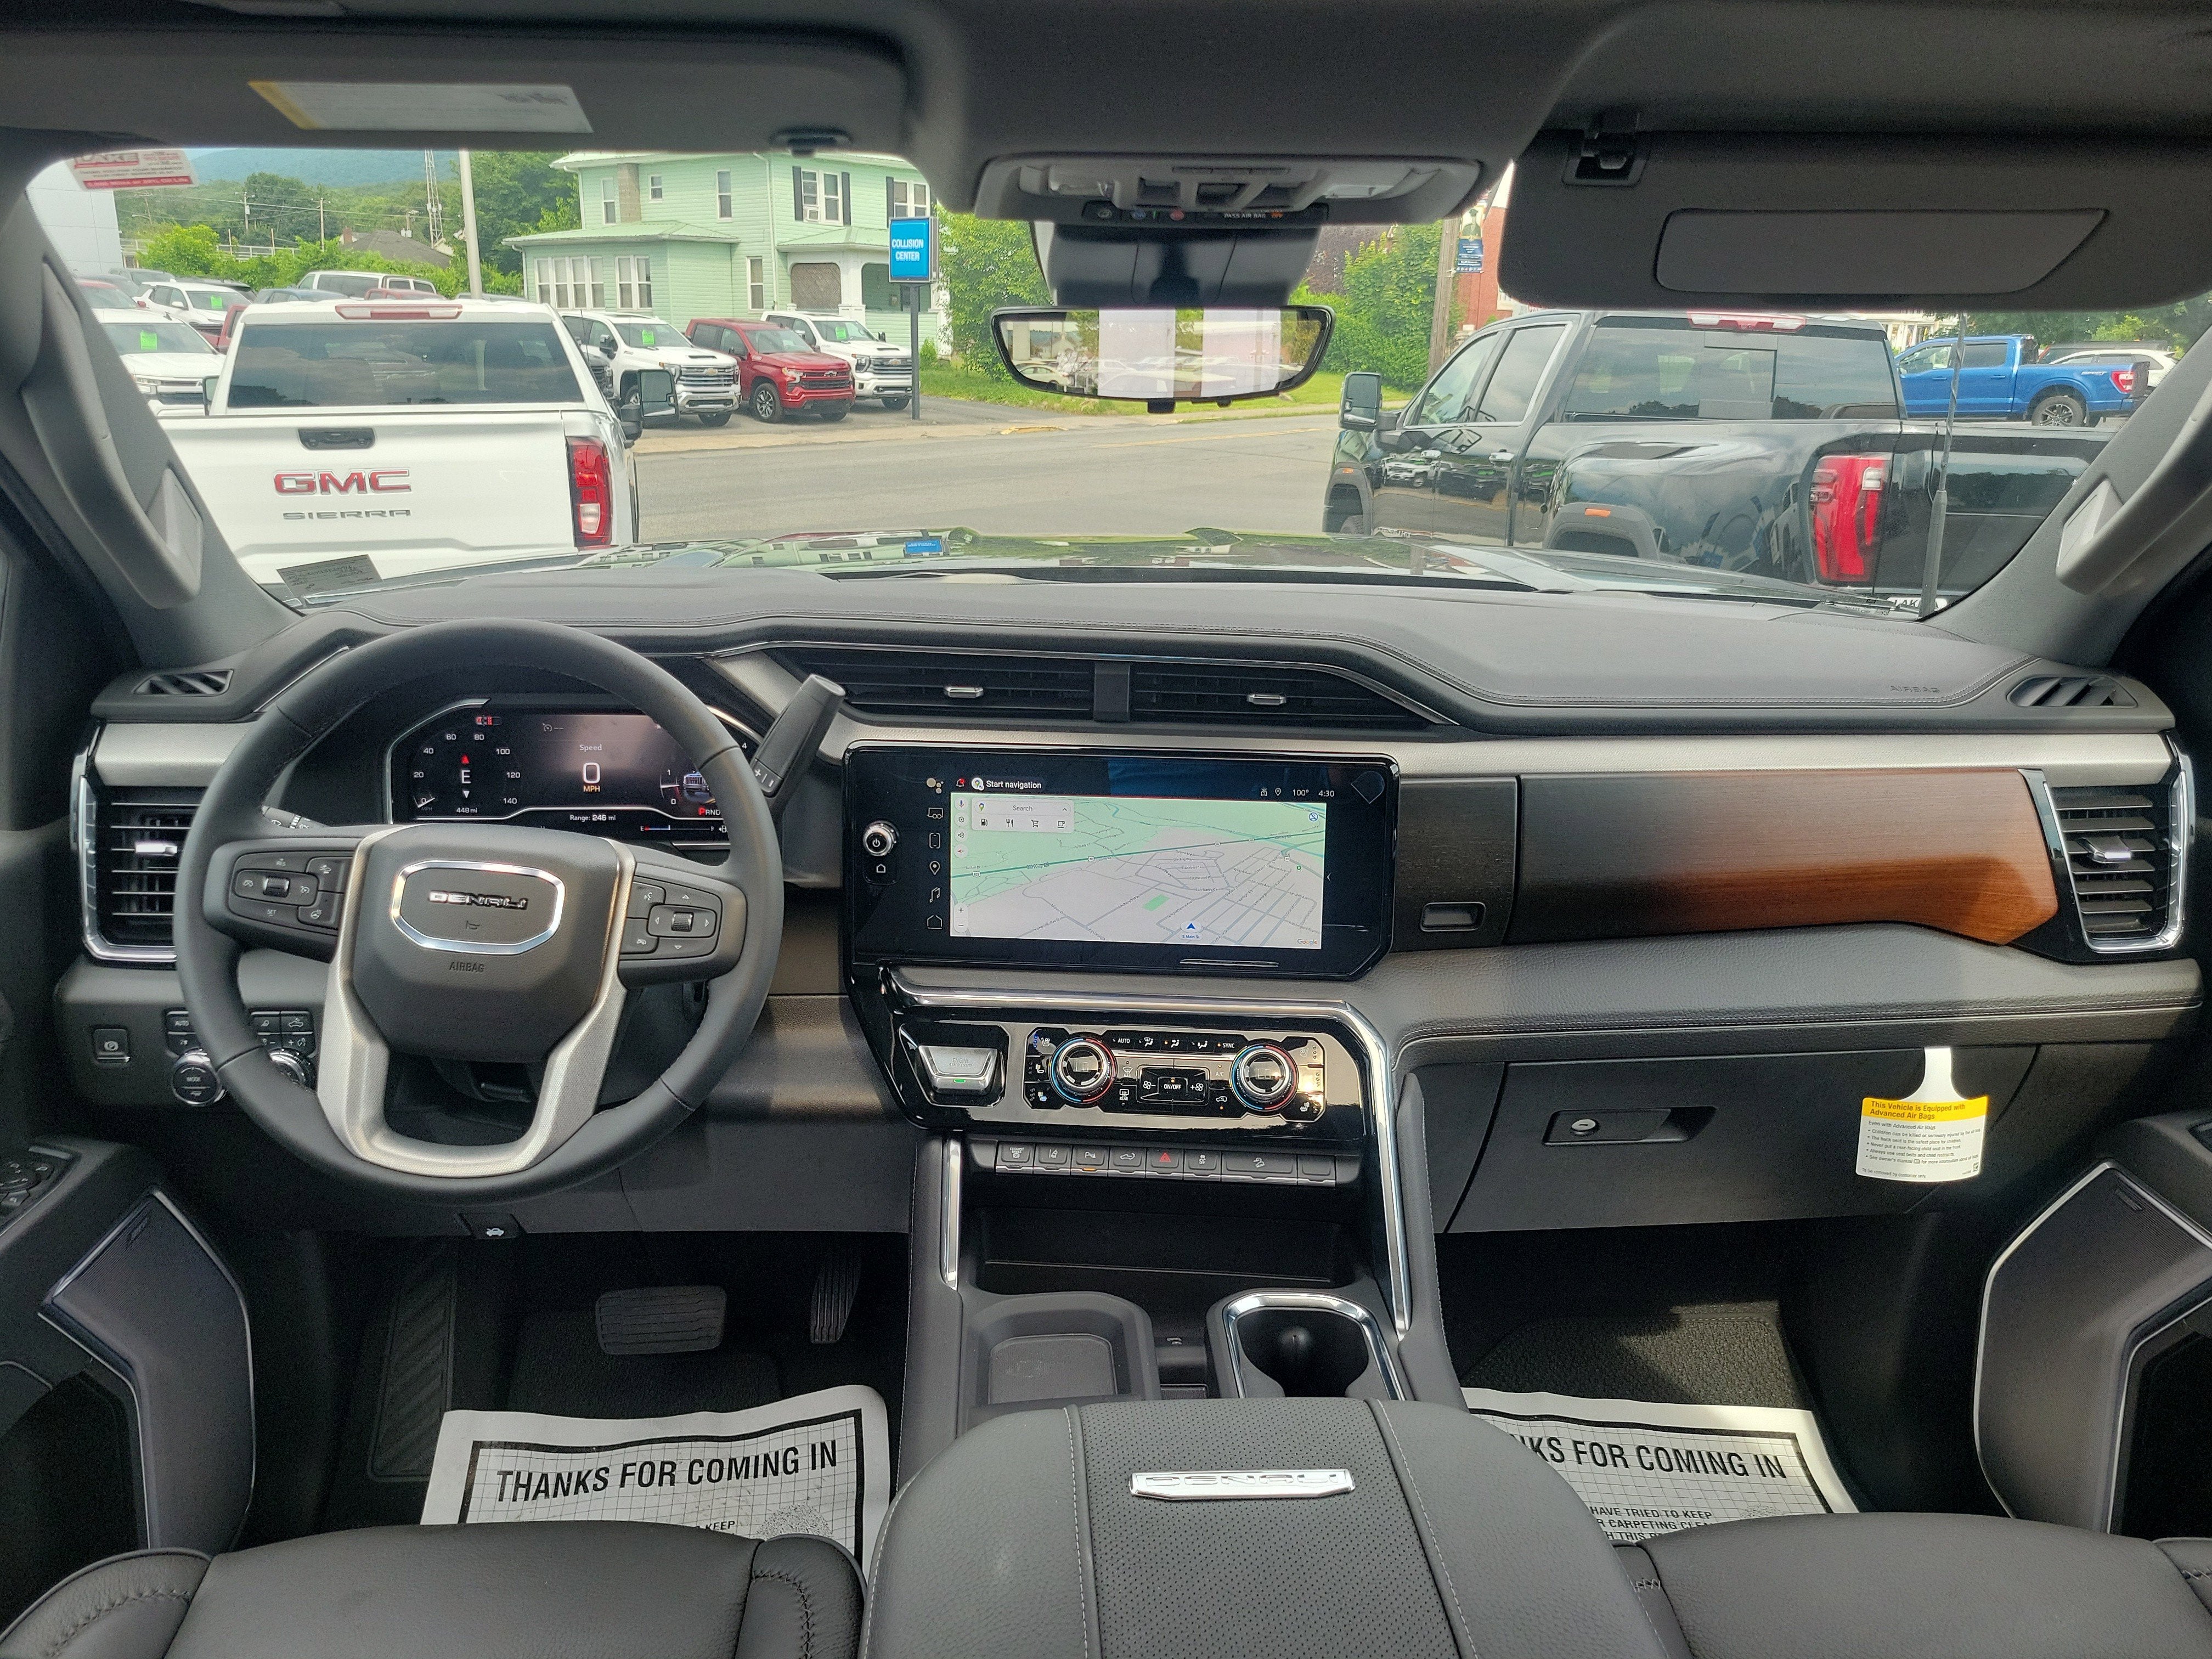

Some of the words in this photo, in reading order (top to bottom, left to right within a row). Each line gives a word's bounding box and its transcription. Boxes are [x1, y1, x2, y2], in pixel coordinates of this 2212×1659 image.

[891, 239, 924, 249] COLLISION
[895, 251, 920, 261] CENTER
[274, 469, 412, 495] GMC
[283, 510, 411, 520] SIERRA
[461, 770, 471, 783] E
[583, 762, 600, 783] 0
[1005, 781, 1042, 790] navigation
[428, 890, 528, 910] DENALI
[449, 961, 485, 973] AIRBAG
[1870, 1109, 1905, 1118] Advanced
[1571, 1440, 1629, 1469] FOR
[1635, 1445, 1749, 1477] COMING
[1753, 1454, 1787, 1479] IN
[497, 1466, 609, 1502] THANKS
[620, 1460, 677, 1488] FOR
[688, 1447, 799, 1485] COMING
[811, 1440, 837, 1470] IN
[1145, 1474, 1339, 1486] DENALI
[1590, 1506, 1622, 1516] HAVE
[1623, 1508, 1660, 1518] TRIED
[1662, 1510, 1679, 1518] TO
[1682, 1510, 1712, 1519] KEEP
[706, 1521, 735, 1530] KEEP
[1609, 1519, 1678, 1530] CARPETING
[1618, 1532, 1647, 1541] THIS
